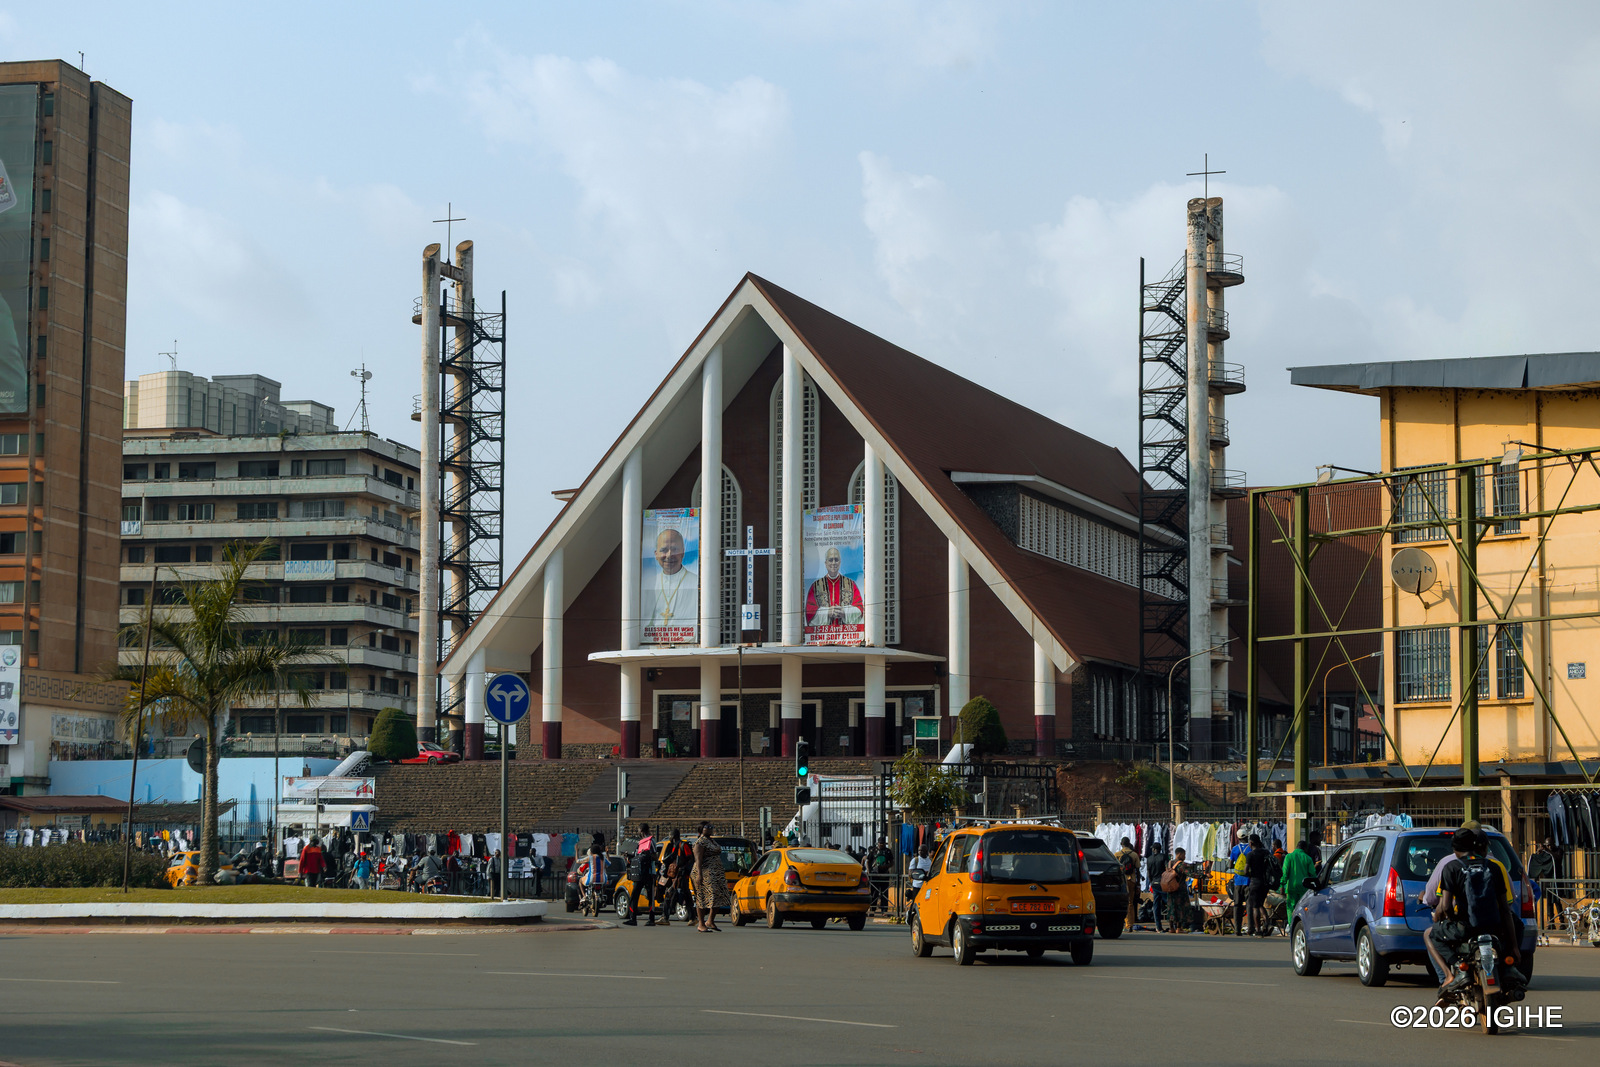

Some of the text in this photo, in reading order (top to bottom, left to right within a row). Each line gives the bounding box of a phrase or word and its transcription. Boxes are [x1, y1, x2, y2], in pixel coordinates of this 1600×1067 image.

[285, 561, 310, 574] GROUPE
[830, 624, 843, 632] Avril
[844, 624, 858, 632] 2026
[842, 632, 860, 640] CELUI
